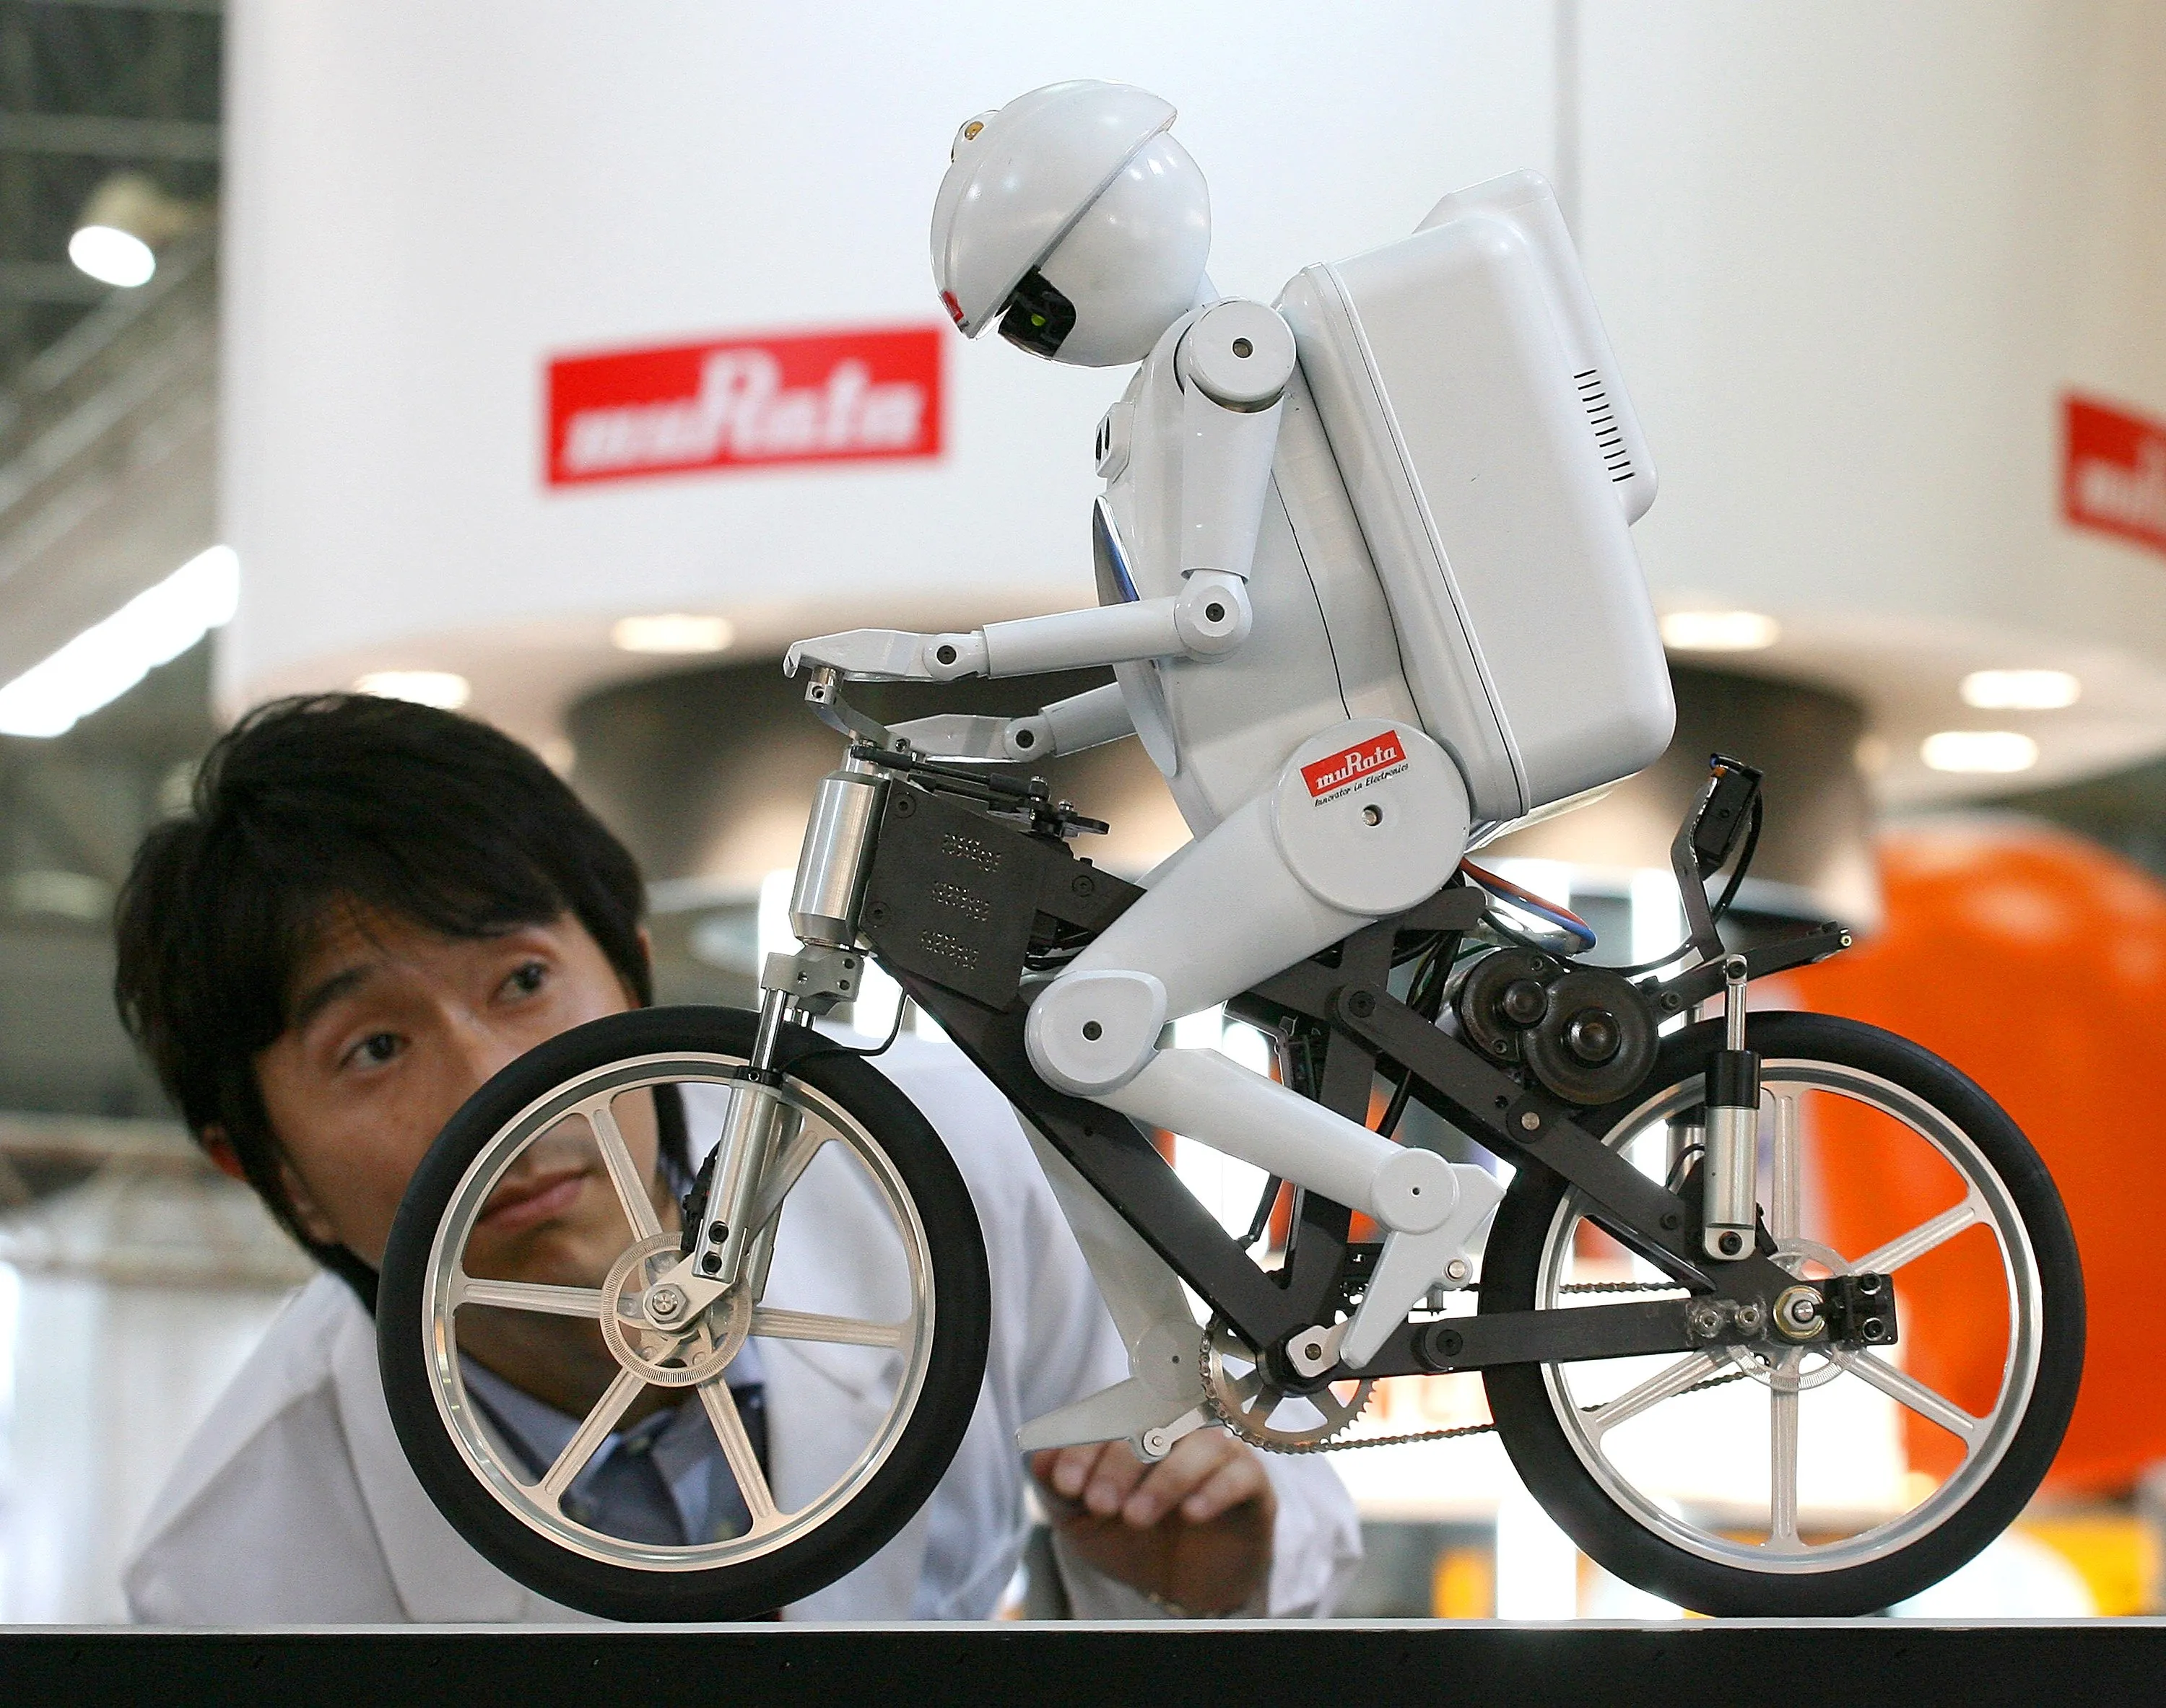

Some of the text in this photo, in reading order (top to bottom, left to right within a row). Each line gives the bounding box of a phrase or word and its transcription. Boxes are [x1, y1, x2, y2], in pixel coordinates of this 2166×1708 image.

[1315, 746, 1396, 789] muRata
[1315, 763, 1409, 807] Innovator in Electronics
